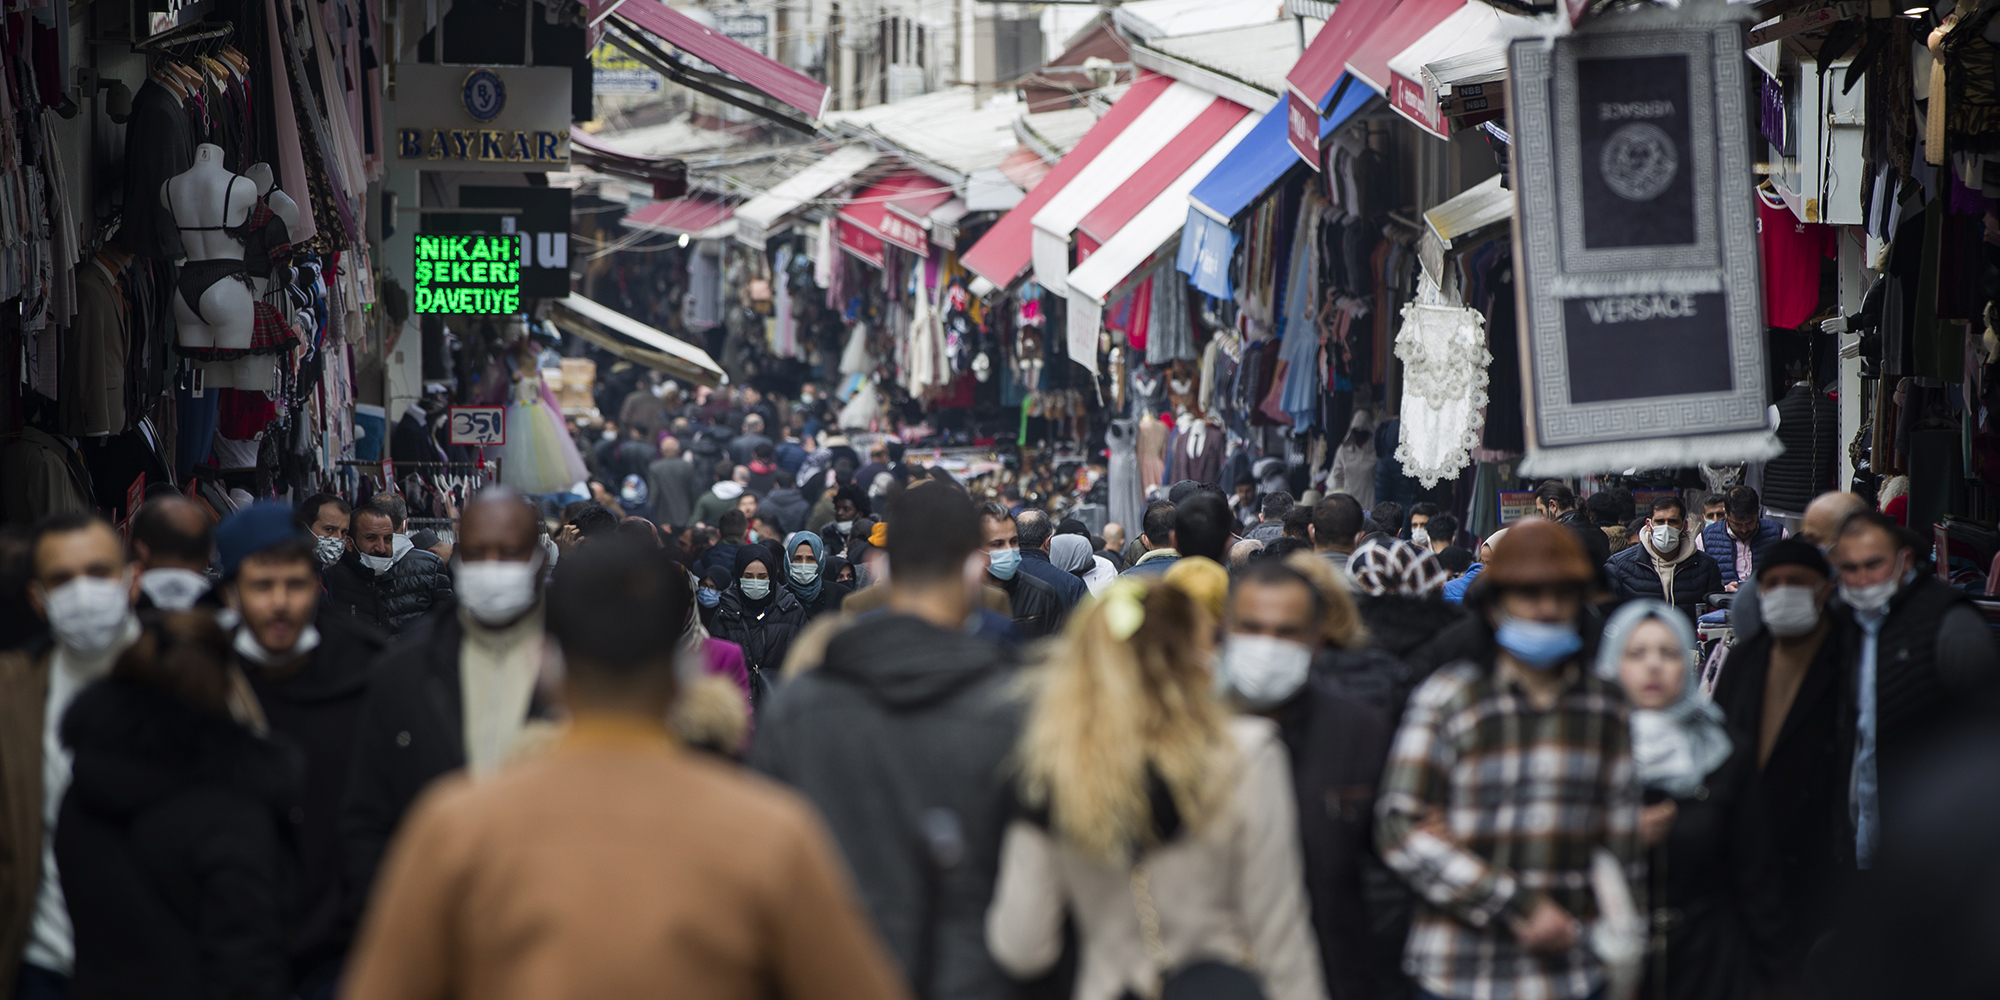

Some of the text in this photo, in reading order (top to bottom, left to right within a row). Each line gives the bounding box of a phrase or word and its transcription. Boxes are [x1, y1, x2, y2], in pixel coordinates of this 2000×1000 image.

[1461, 86, 1482, 96] NBB
[1465, 99, 1487, 110] NBB
[1599, 101, 1677, 119] VERSACE
[399, 128, 569, 164] BAYKAR
[1585, 293, 1698, 324] VERSACE
